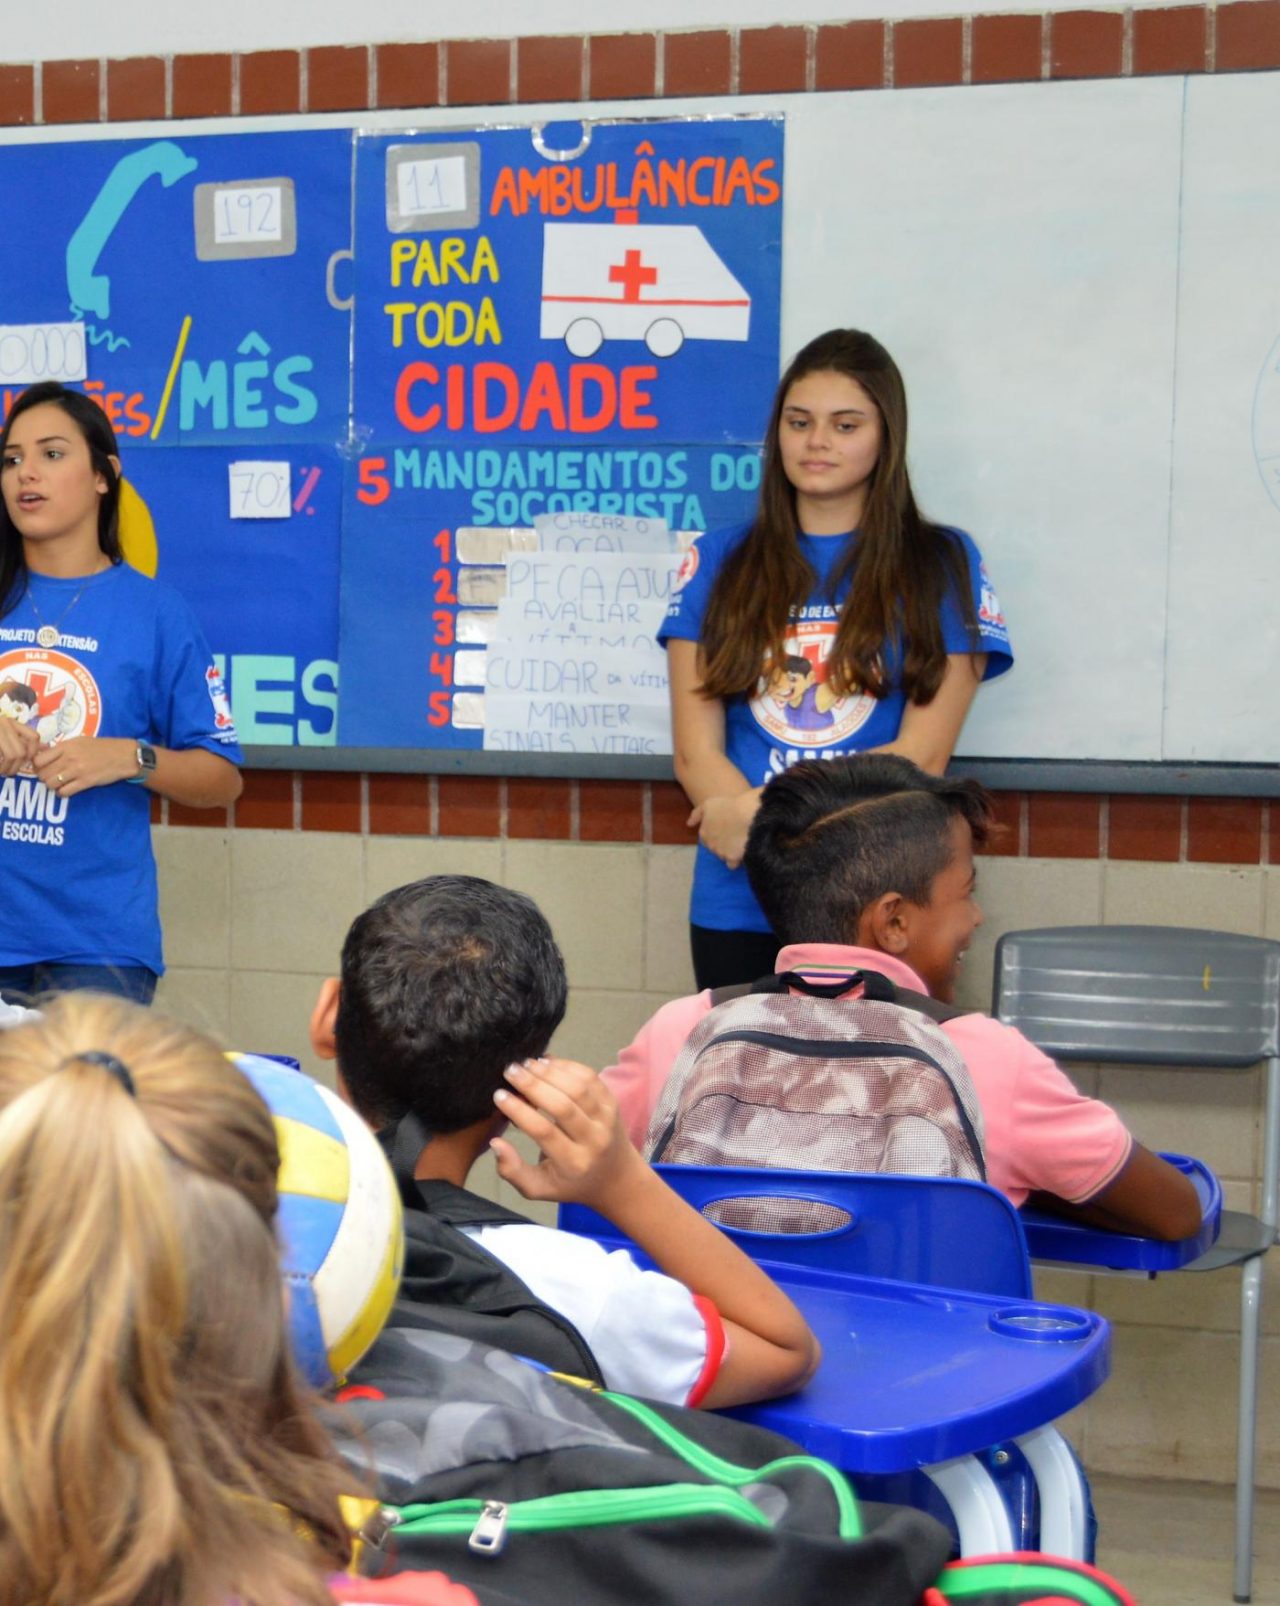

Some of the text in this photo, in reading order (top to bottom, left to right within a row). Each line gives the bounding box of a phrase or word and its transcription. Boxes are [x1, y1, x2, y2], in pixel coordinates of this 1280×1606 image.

[406, 163, 451, 210] 11
[489, 140, 780, 216] AMBULÂNCIAS
[218, 191, 279, 238] 192
[391, 236, 500, 287] PARA
[384, 296, 502, 348] TODA
[395, 361, 659, 433] CIDADE
[357, 448, 763, 506] 5 MANDAMENTOS DO
[433, 528, 451, 564] 1
[433, 568, 457, 604] 2
[432, 611, 454, 646] 3
[24, 652, 49, 660] NAS
[73, 667, 98, 716] ESCOLAS
[429, 652, 452, 687] 4
[486, 656, 599, 694] CUIDAR
[427, 692, 451, 728] 5
[528, 701, 631, 729] MANTER
[1, 820, 65, 847] ESCOLAS
